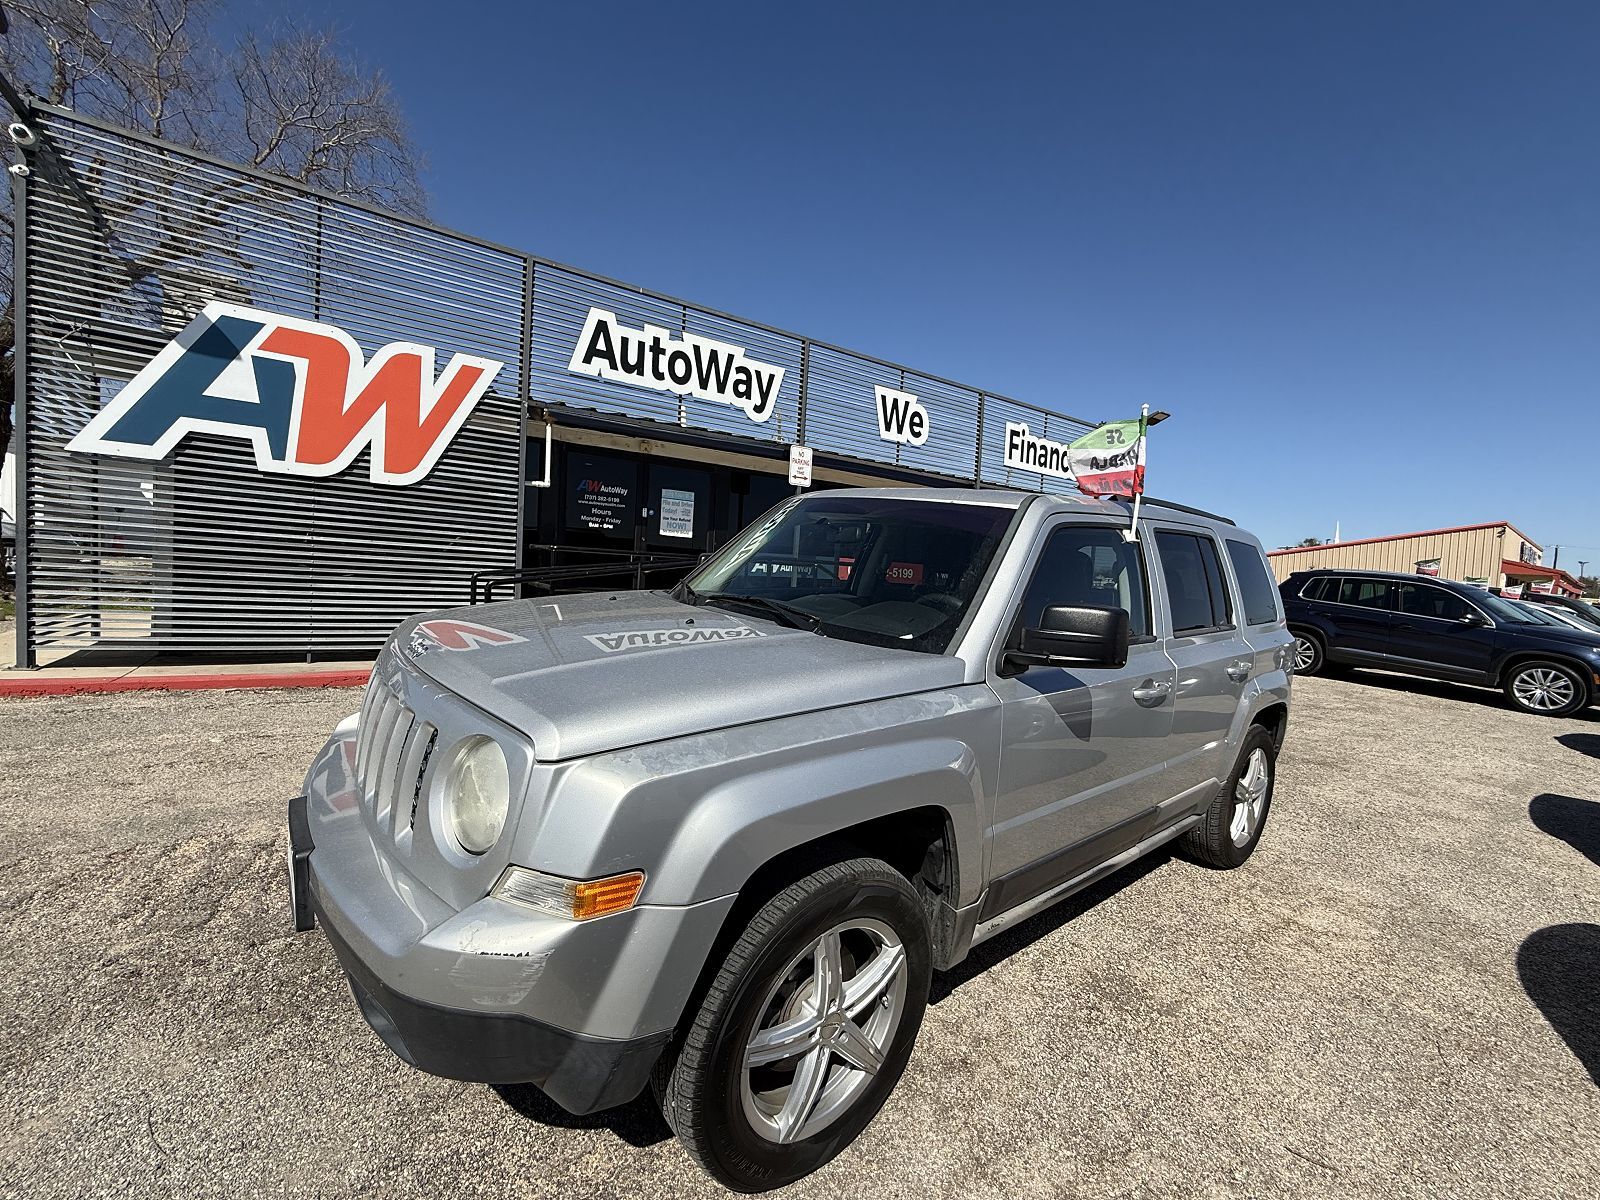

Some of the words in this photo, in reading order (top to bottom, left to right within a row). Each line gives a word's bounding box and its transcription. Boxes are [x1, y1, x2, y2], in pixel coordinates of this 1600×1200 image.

[582, 318, 776, 415] AutoWay
[98, 314, 486, 475] AW
[881, 394, 924, 439] We
[1008, 428, 1070, 473] Financ
[792, 457, 810, 466] PARKING
[600, 485, 628, 496] AutoWay
[591, 507, 612, 516] Hours
[580, 515, 602, 523] Monday
[605, 517, 622, 525] Friday
[666, 521, 687, 530] NOW!
